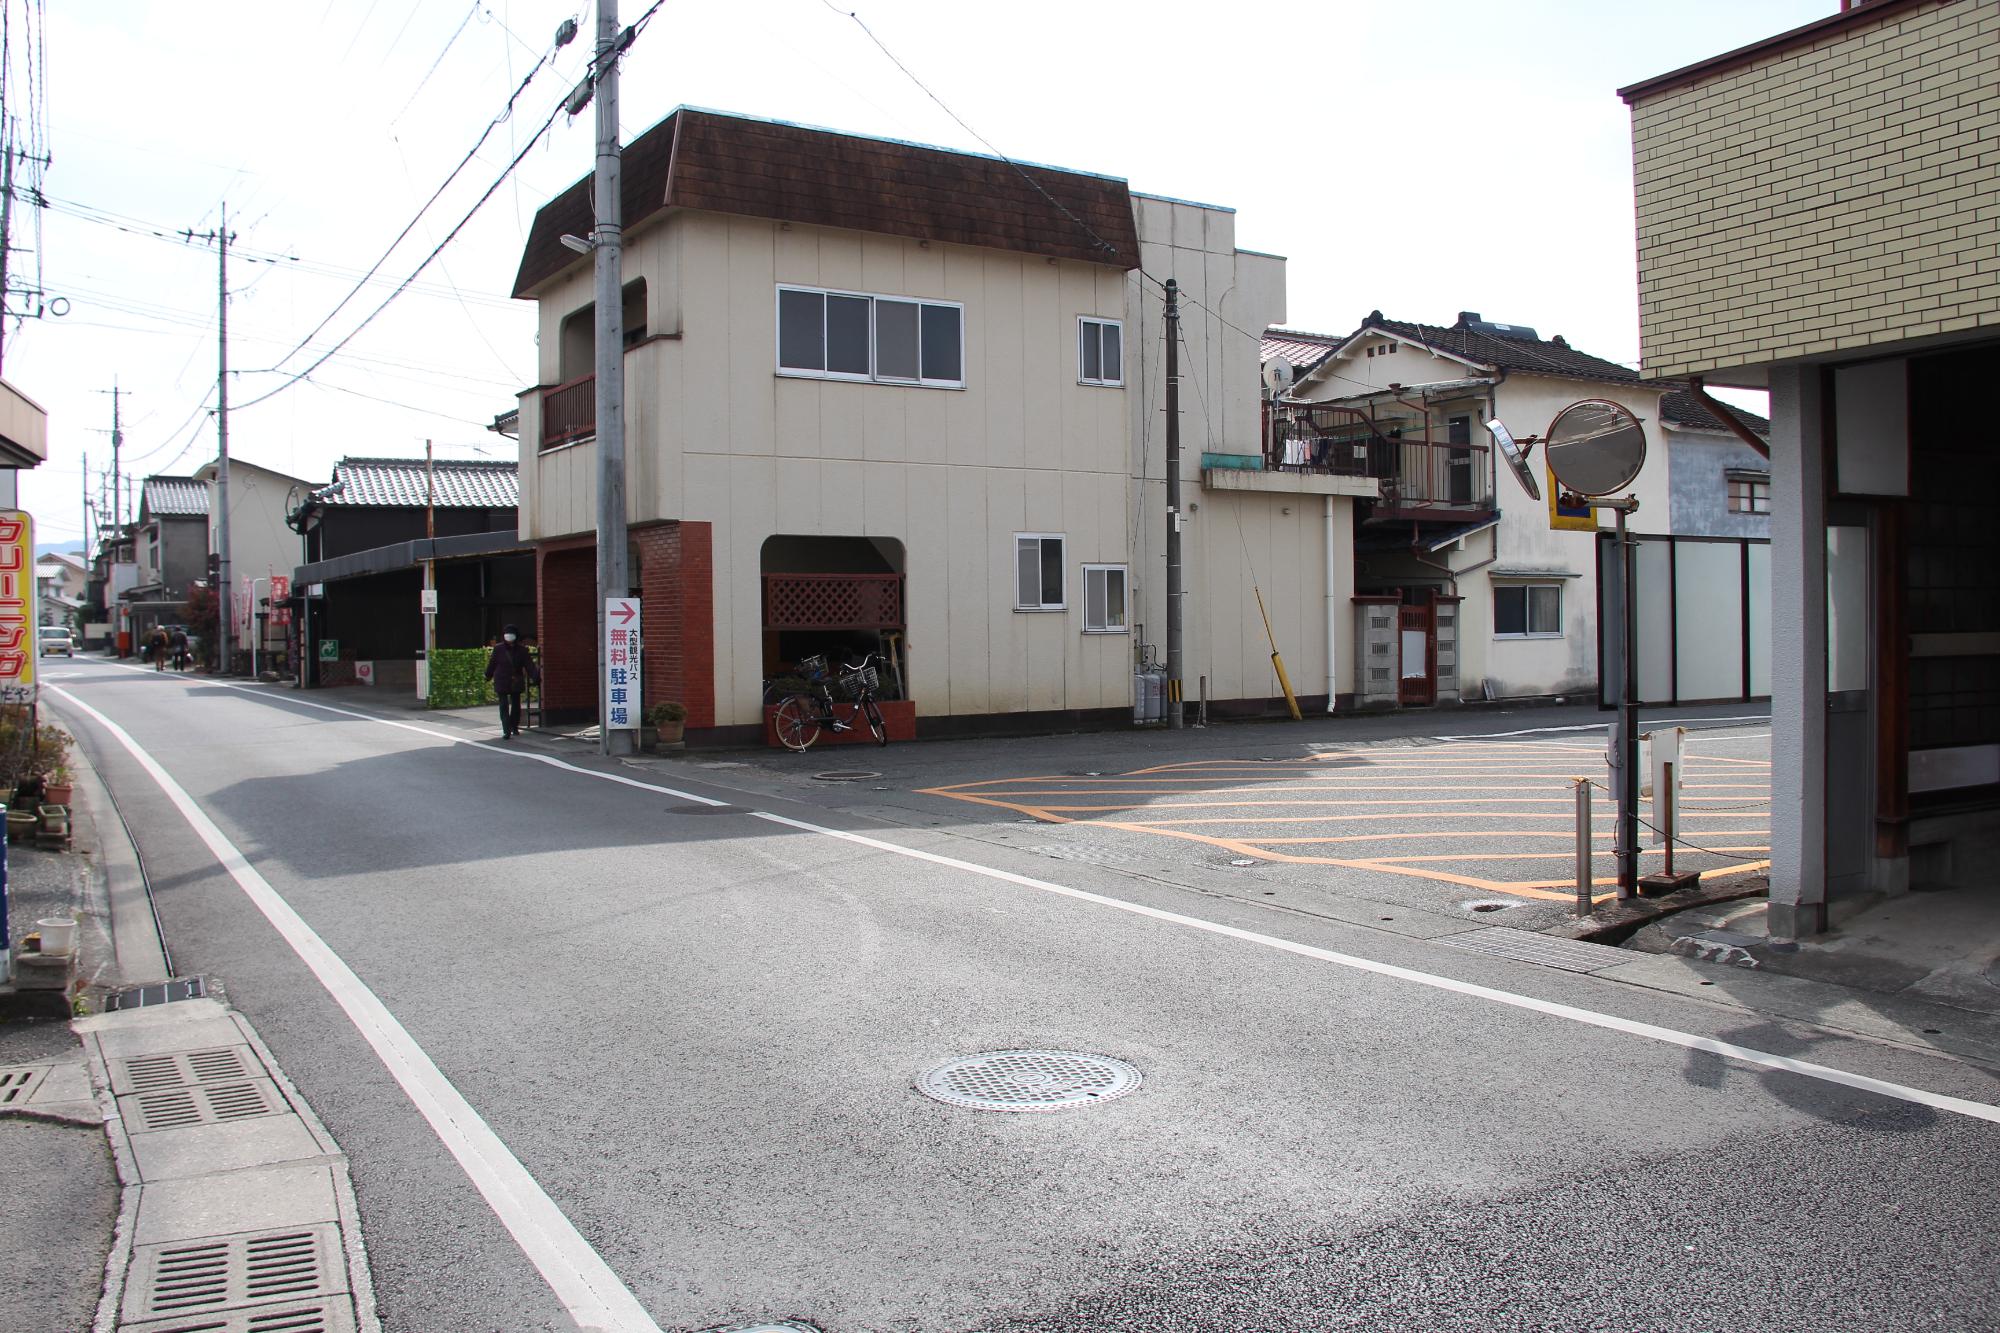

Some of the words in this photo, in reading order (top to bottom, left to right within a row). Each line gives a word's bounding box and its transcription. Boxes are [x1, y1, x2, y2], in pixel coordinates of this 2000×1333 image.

[610, 629, 628, 725] 無料駐車場
[629, 629, 638, 681] 大型観光バス
